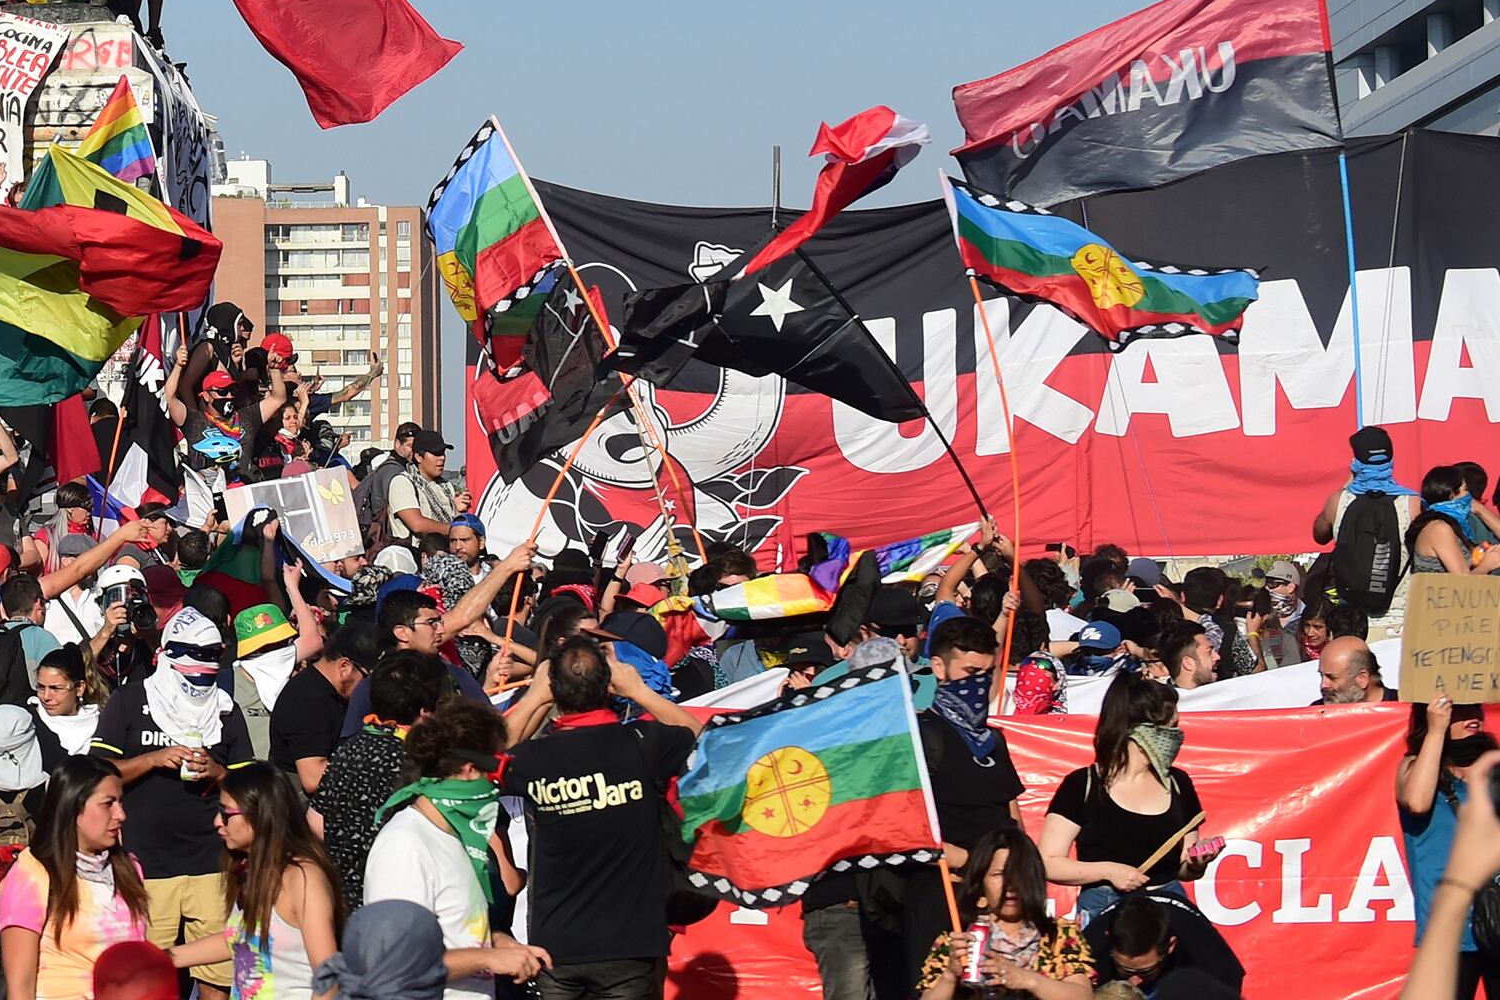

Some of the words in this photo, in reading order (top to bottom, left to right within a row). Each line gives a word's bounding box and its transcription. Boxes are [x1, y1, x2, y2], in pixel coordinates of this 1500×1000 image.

[1432, 615, 1500, 637] PIÑE
[1412, 648, 1434, 668] TE
[592, 772, 643, 810] Jara
